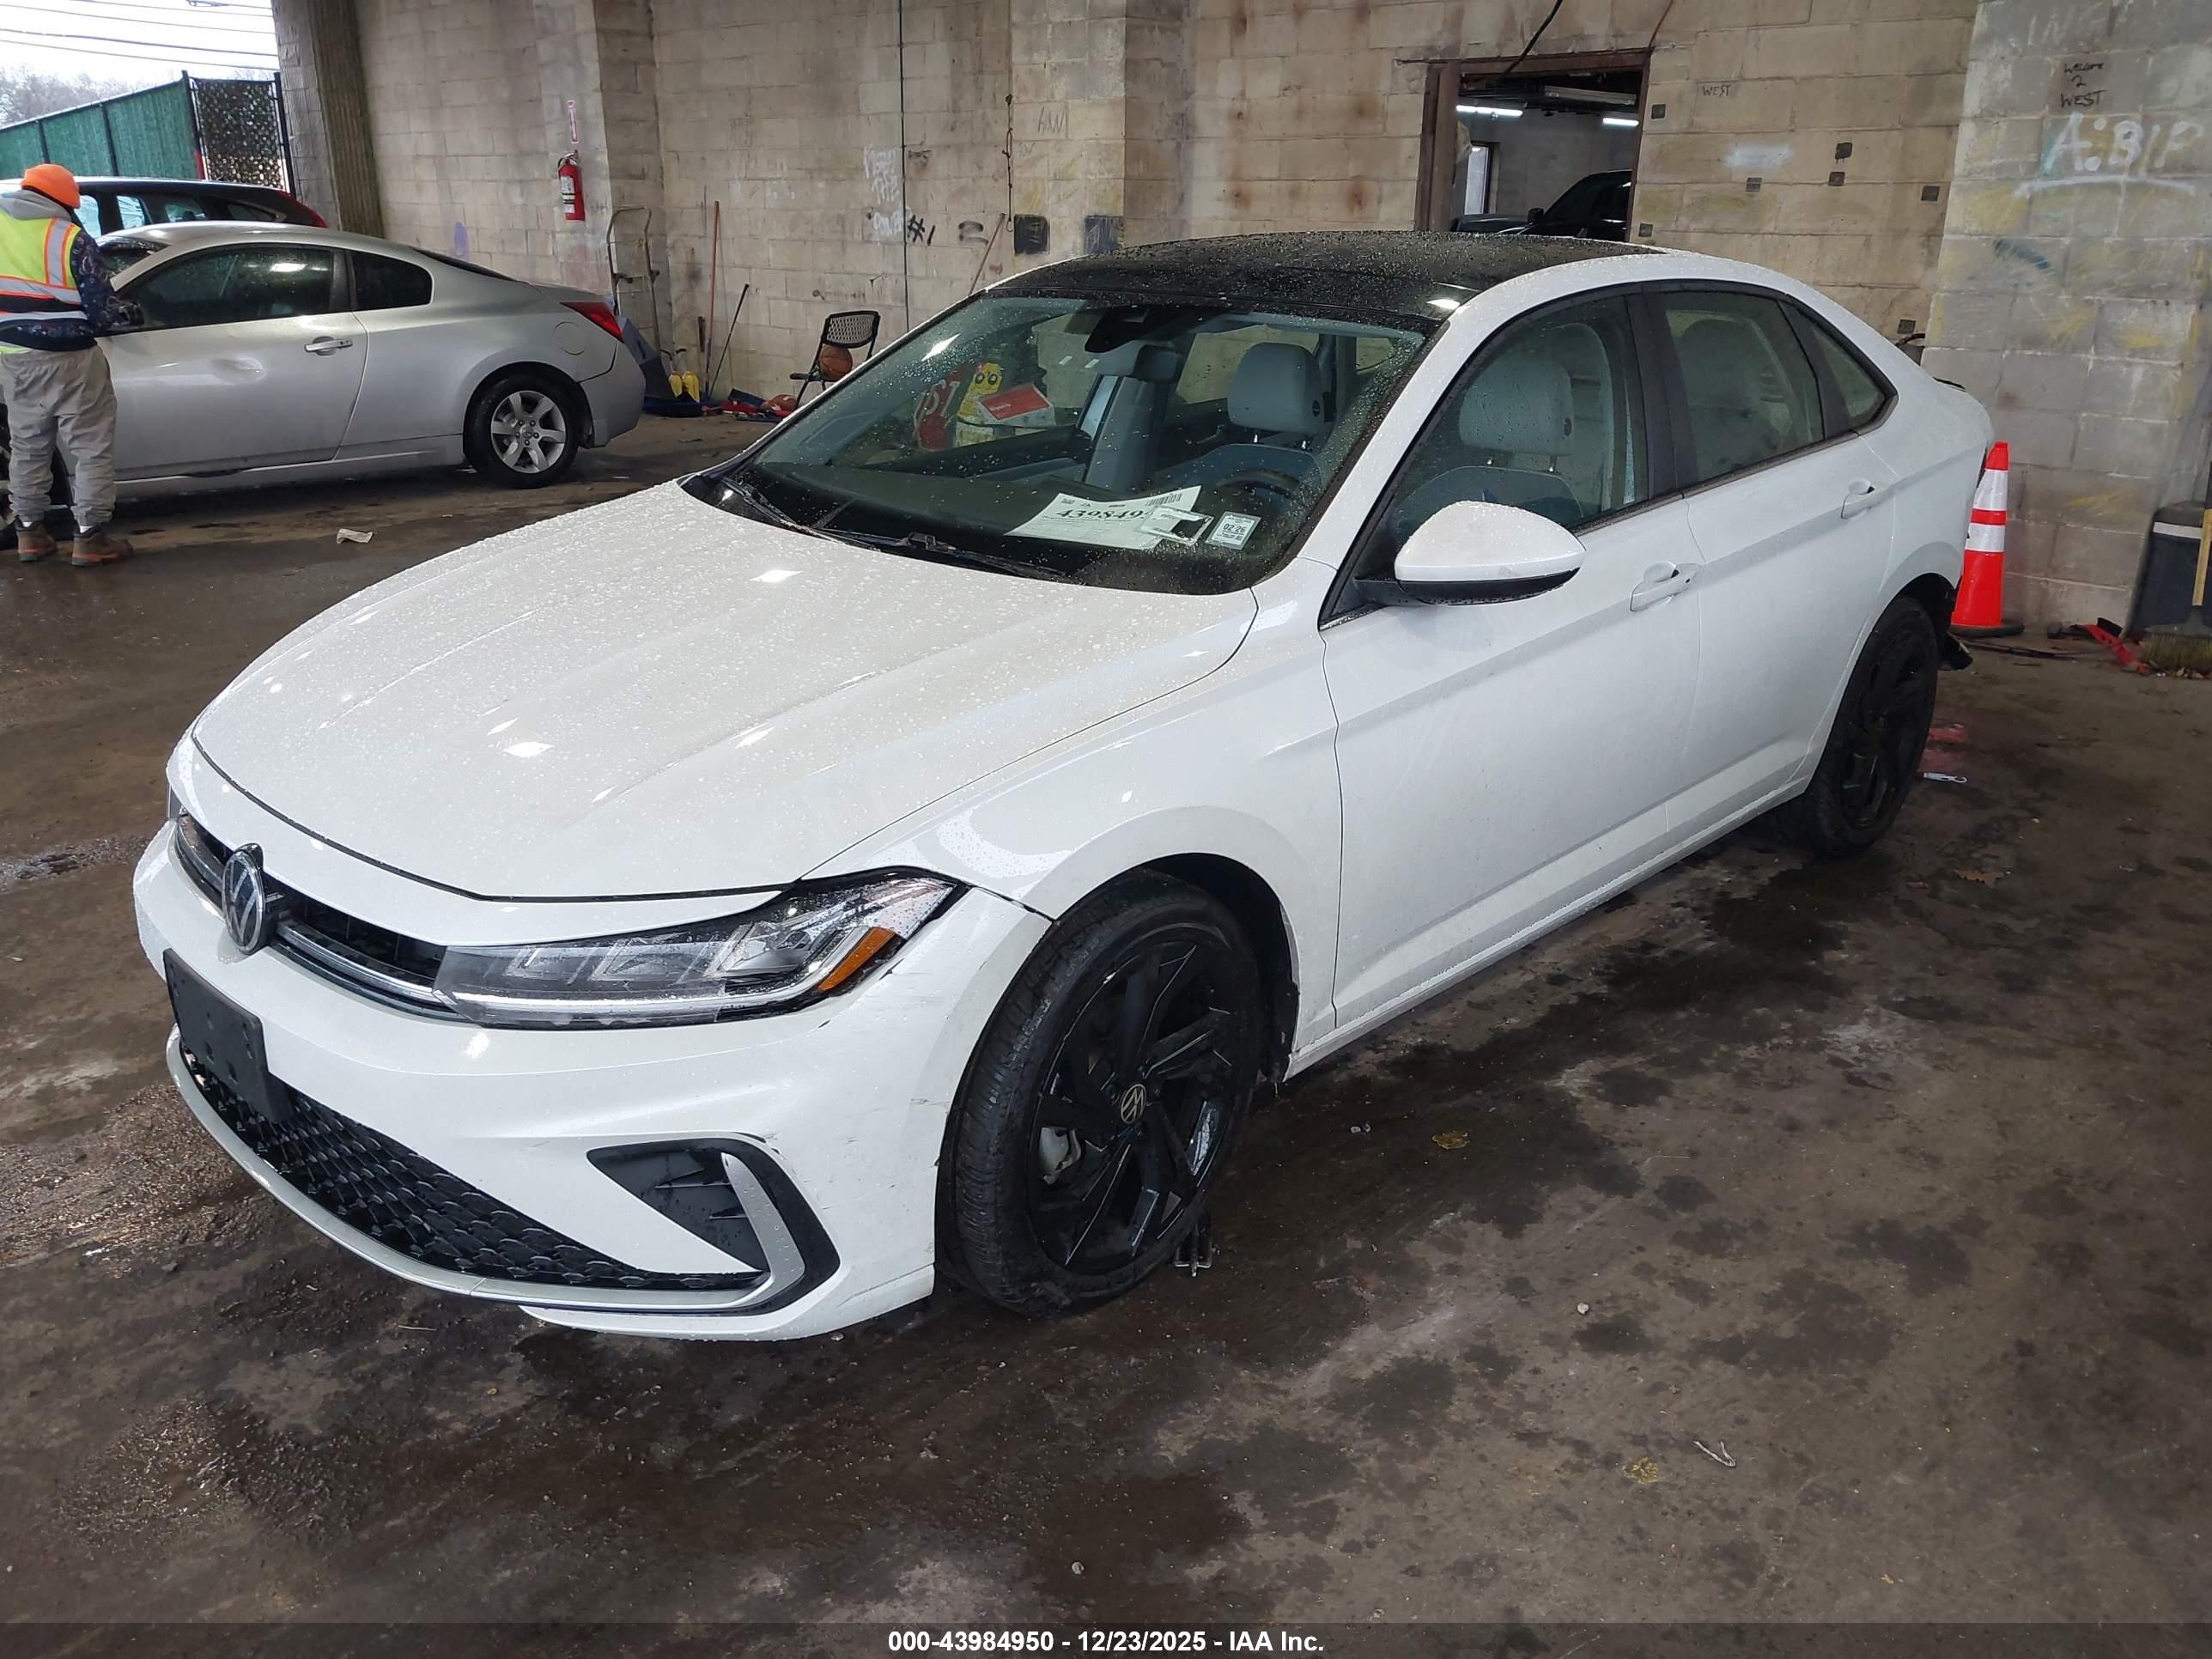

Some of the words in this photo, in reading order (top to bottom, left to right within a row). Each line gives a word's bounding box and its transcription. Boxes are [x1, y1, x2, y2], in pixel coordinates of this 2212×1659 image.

[2071, 75, 2087, 87] 2
[1702, 83, 1732, 96] WEST
[2061, 89, 2107, 108] WEST
